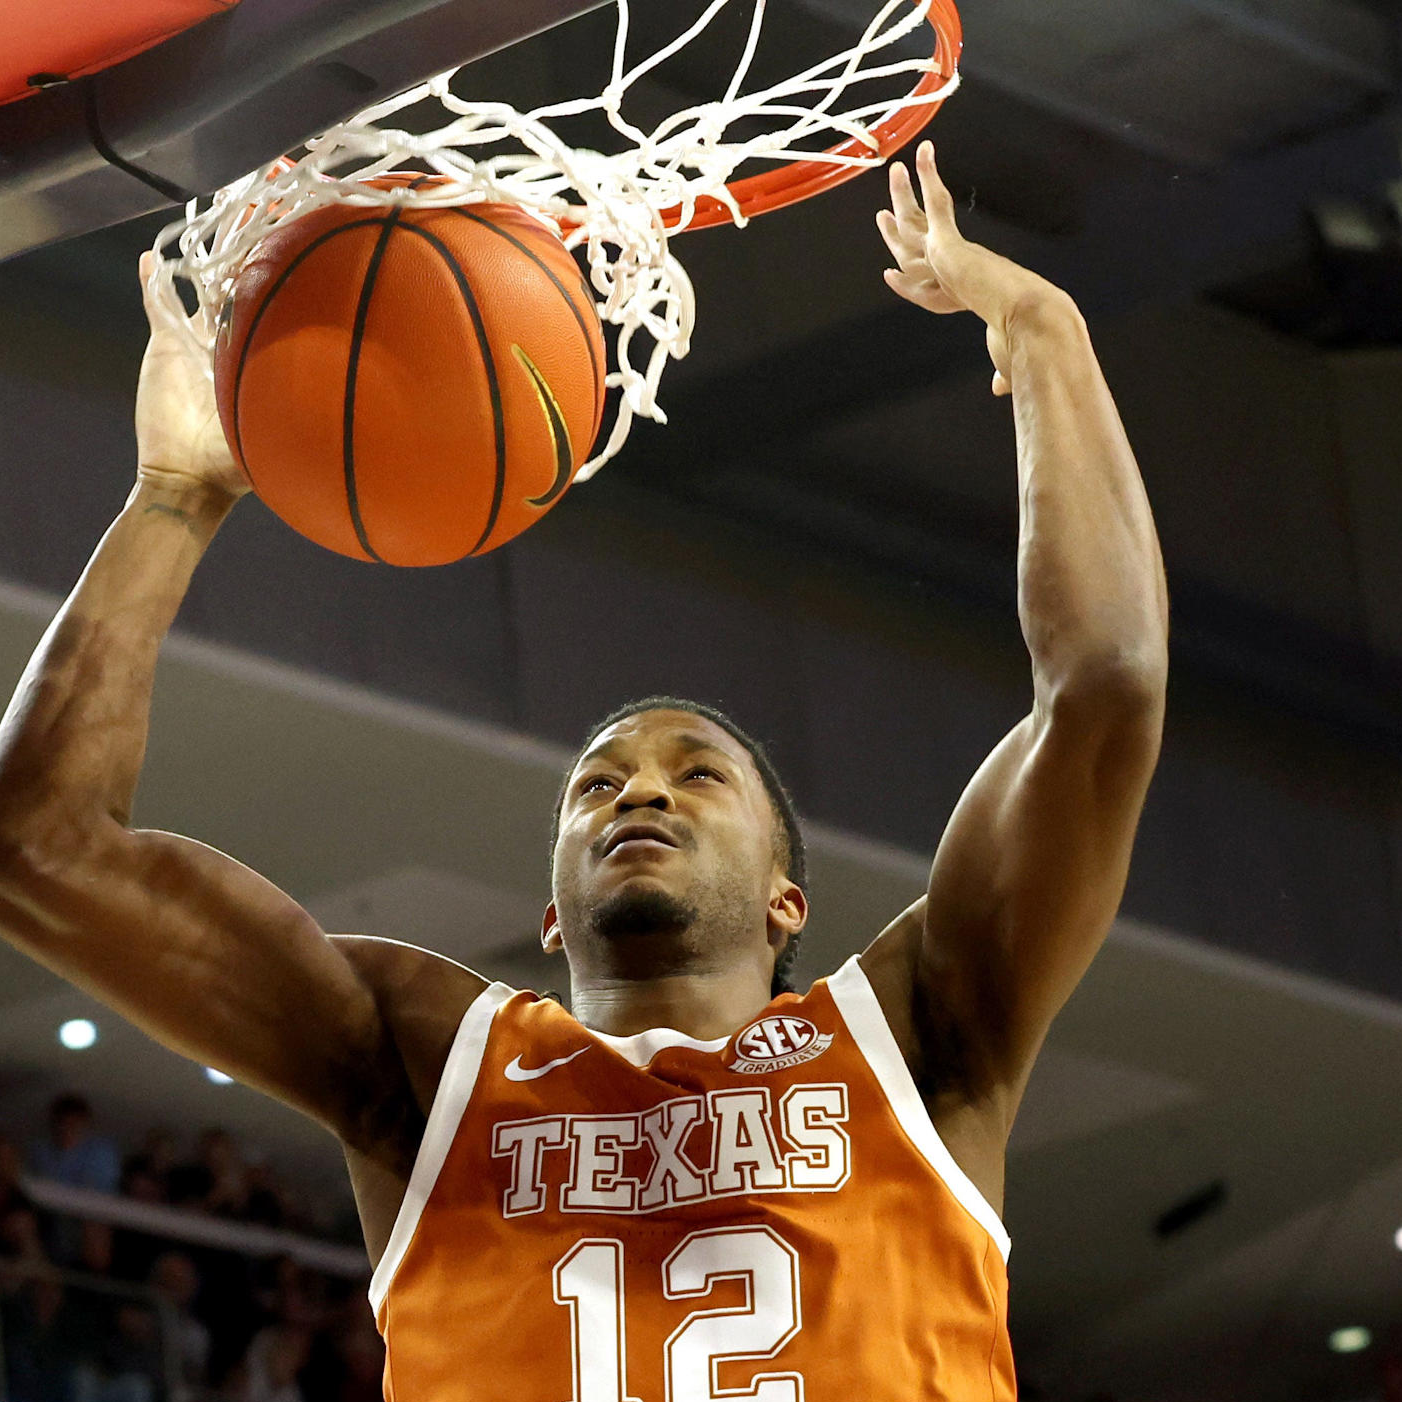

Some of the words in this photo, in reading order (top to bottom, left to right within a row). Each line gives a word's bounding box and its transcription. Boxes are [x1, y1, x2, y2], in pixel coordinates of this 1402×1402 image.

[741, 1017, 812, 1059] SEC
[742, 1044, 827, 1074] GRADUATE
[491, 1083, 852, 1219] TEXAS
